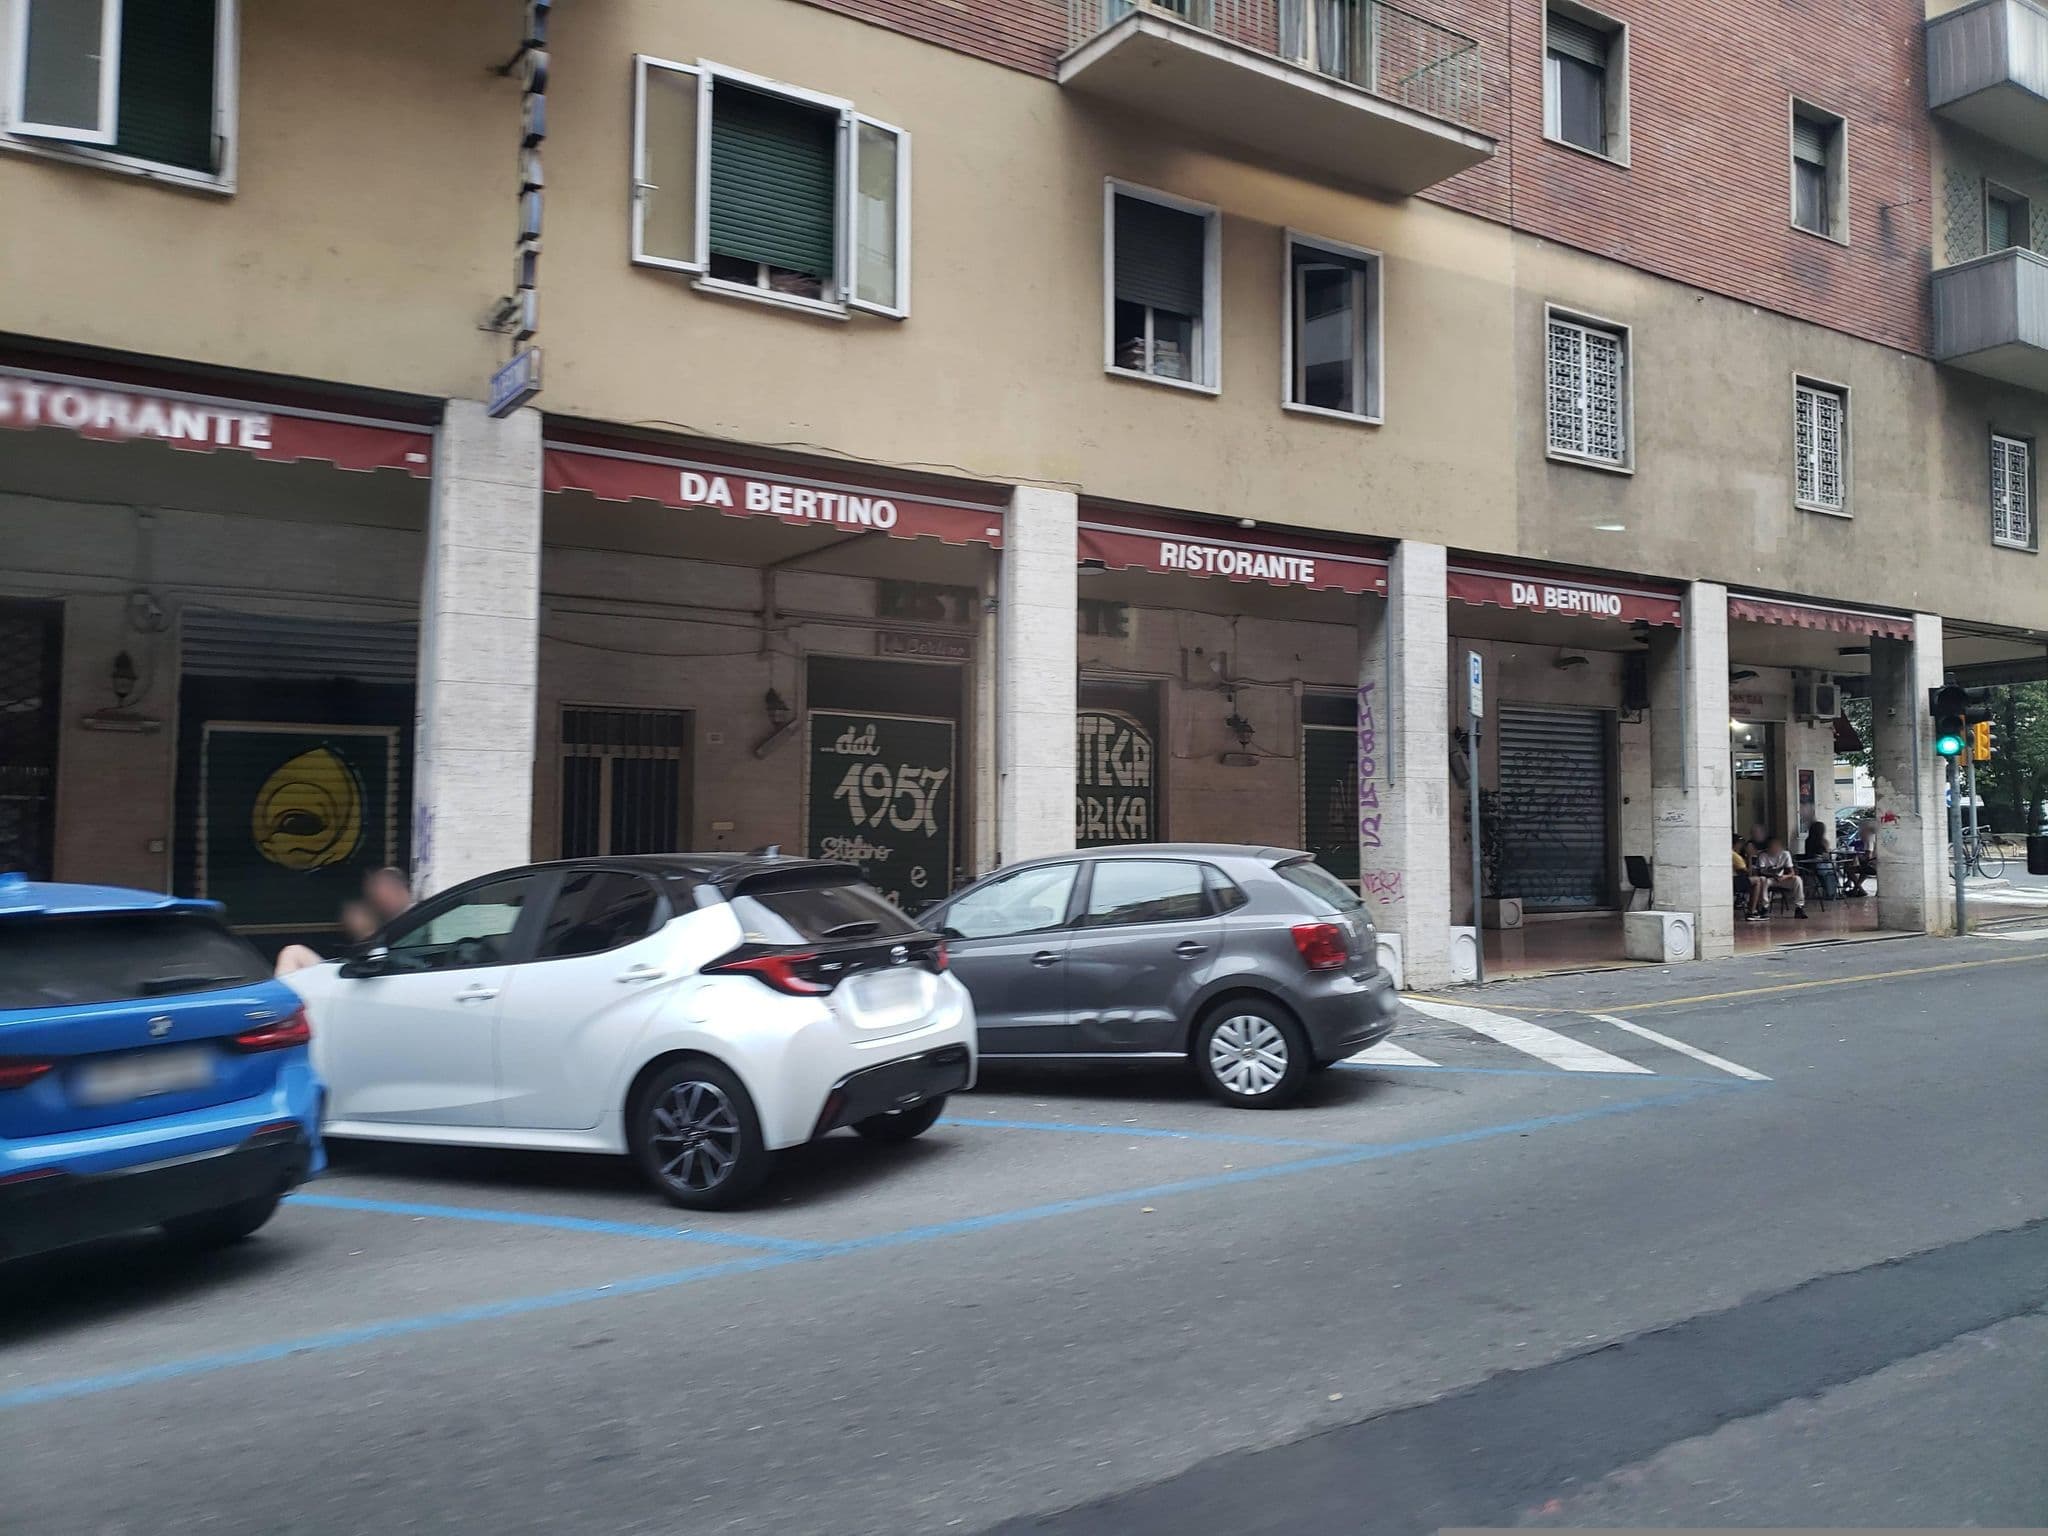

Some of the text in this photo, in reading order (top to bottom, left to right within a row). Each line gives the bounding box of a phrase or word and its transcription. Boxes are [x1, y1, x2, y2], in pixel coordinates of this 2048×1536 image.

[680, 472, 898, 529] DA BERTINO
[1160, 542, 1315, 583] RISTORANTE
[1511, 583, 1622, 616] DA BERTINO
[1077, 716, 1150, 787] TECA
[833, 762, 950, 838] 1957
